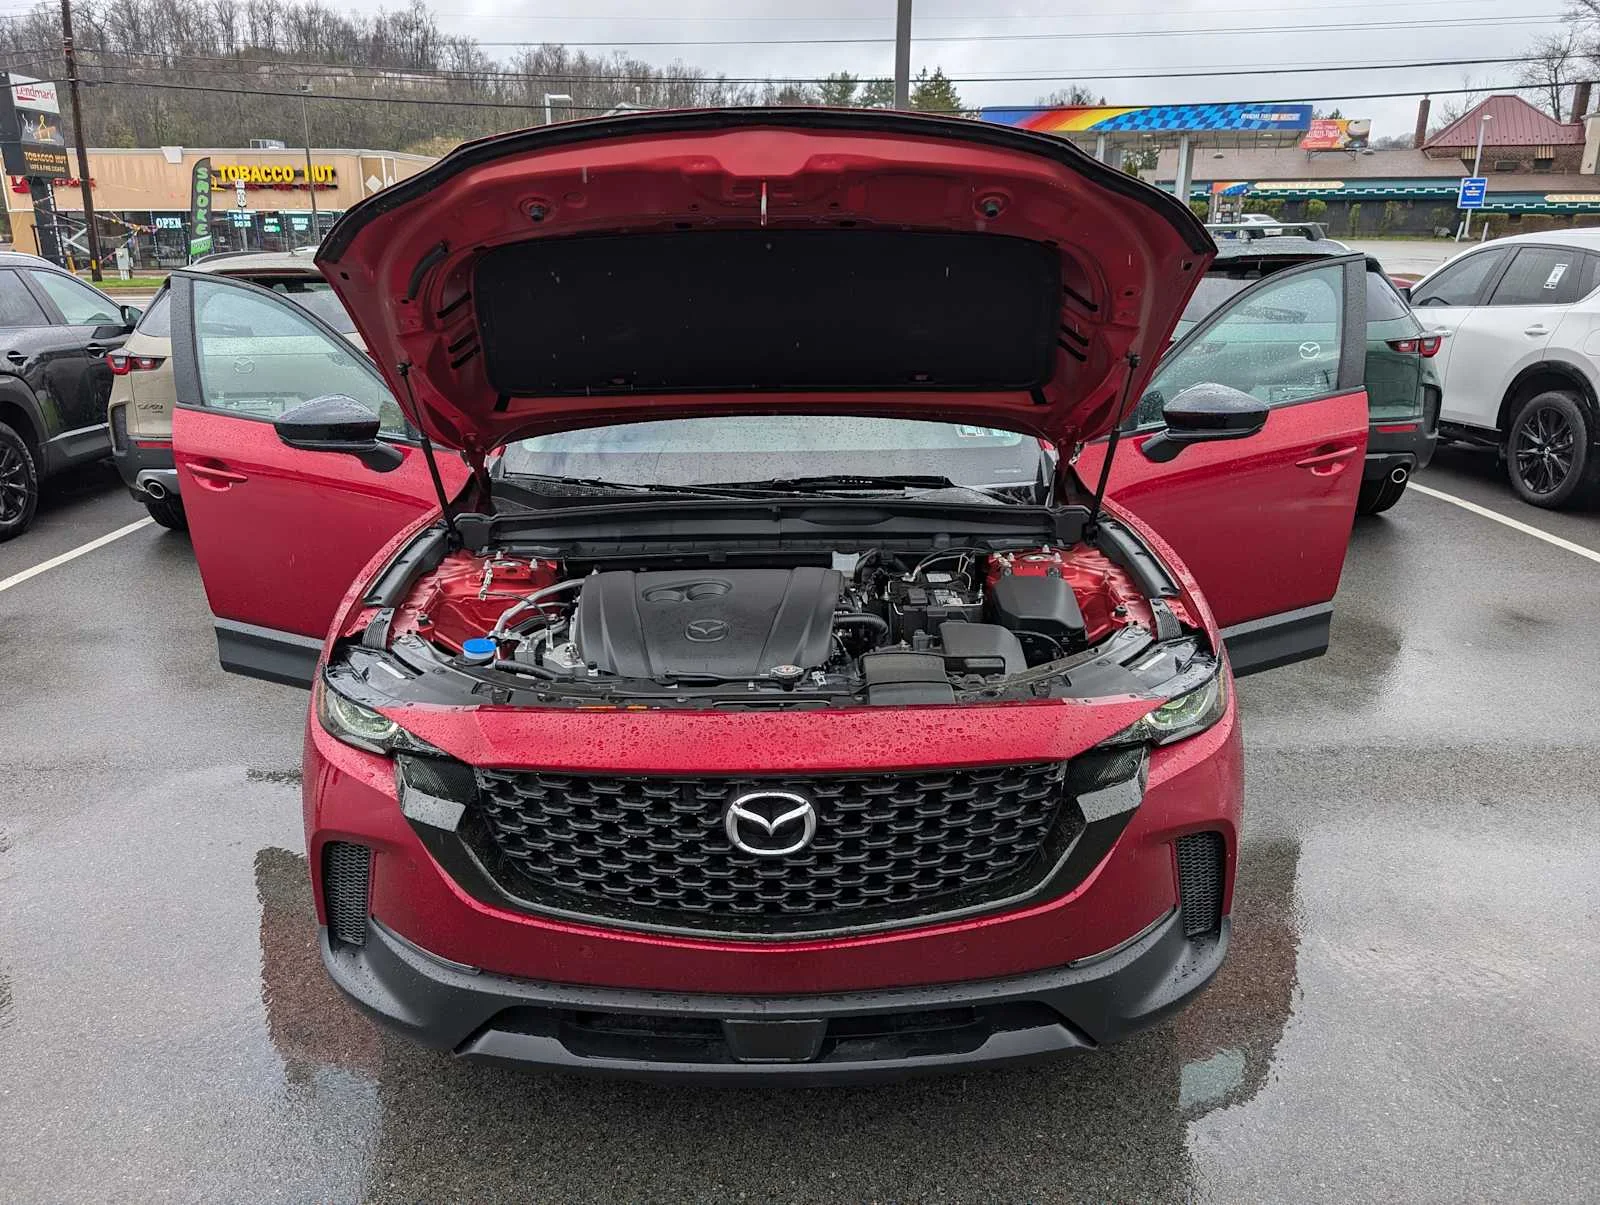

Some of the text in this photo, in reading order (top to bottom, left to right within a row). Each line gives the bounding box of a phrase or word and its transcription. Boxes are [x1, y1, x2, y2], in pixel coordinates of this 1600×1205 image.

[16, 85, 56, 101] Lendmark
[24, 151, 55, 162] TOBACCO
[219, 164, 295, 183] TOBACCO
[196, 167, 210, 236] SMOKE
[155, 217, 183, 229] OPEN
